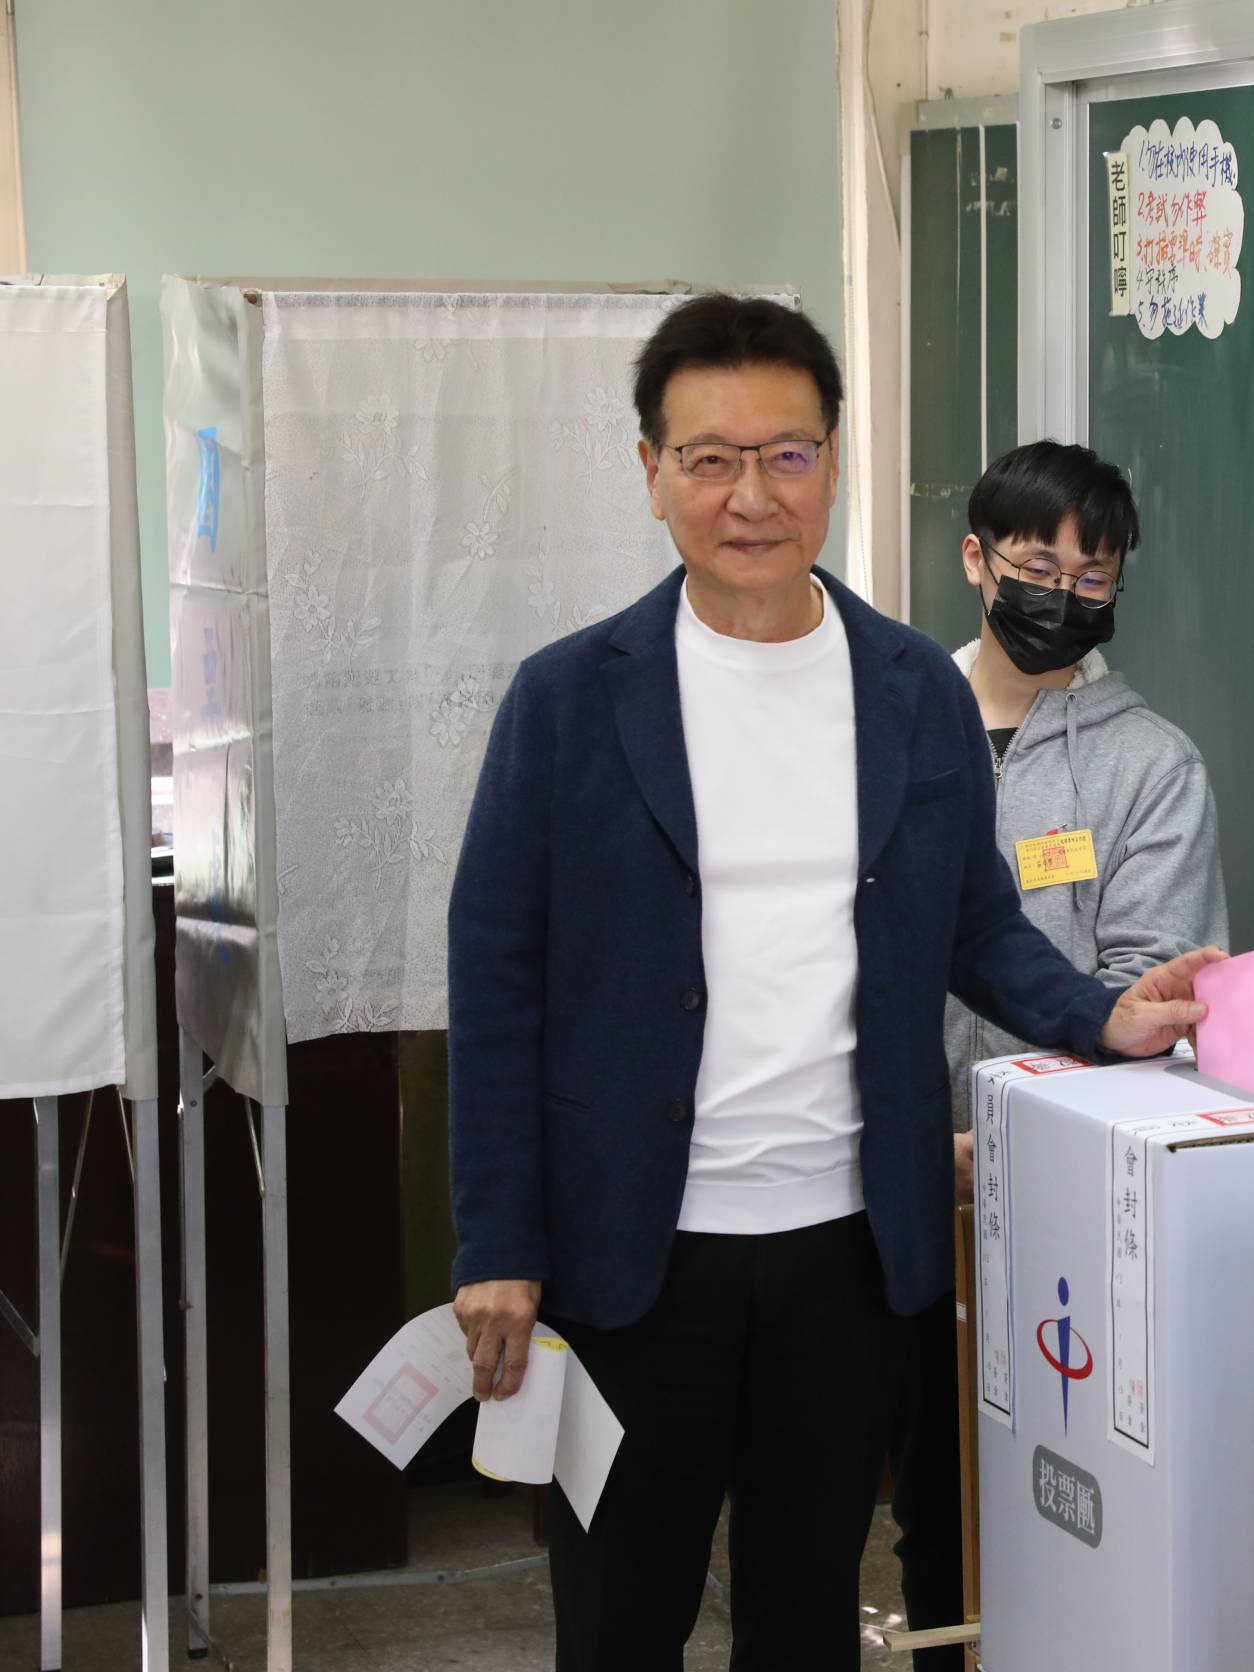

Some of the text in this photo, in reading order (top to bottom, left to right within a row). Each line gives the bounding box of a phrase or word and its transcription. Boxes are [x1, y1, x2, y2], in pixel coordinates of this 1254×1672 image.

[1111, 161, 1127, 297] 老師叮嚀
[1040, 1458, 1095, 1534] 投票匭
